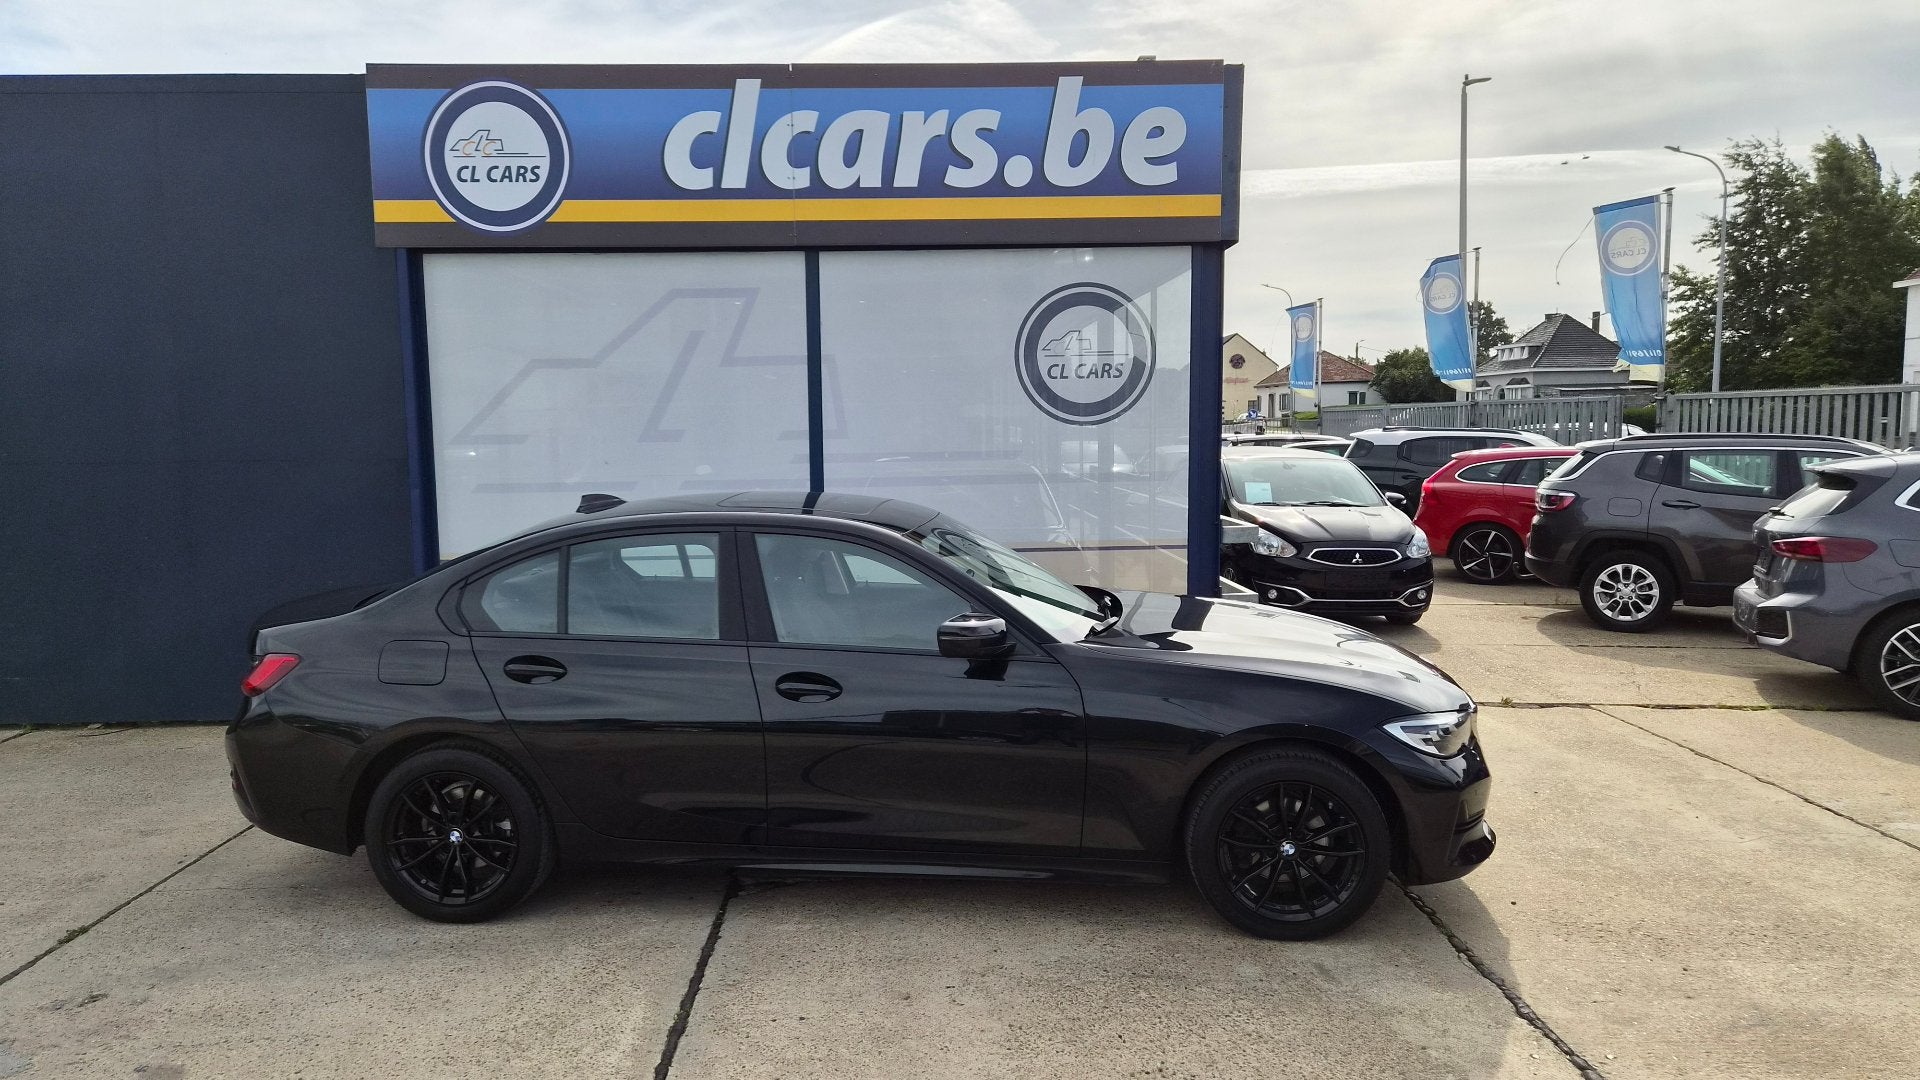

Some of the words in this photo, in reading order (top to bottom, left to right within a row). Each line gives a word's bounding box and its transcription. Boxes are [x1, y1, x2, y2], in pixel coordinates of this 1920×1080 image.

[663, 76, 1187, 190] clcars.be
[456, 165, 481, 183] CL
[486, 165, 541, 183] CARS
[1046, 363, 1069, 379] CL
[1074, 362, 1124, 379] CARS
